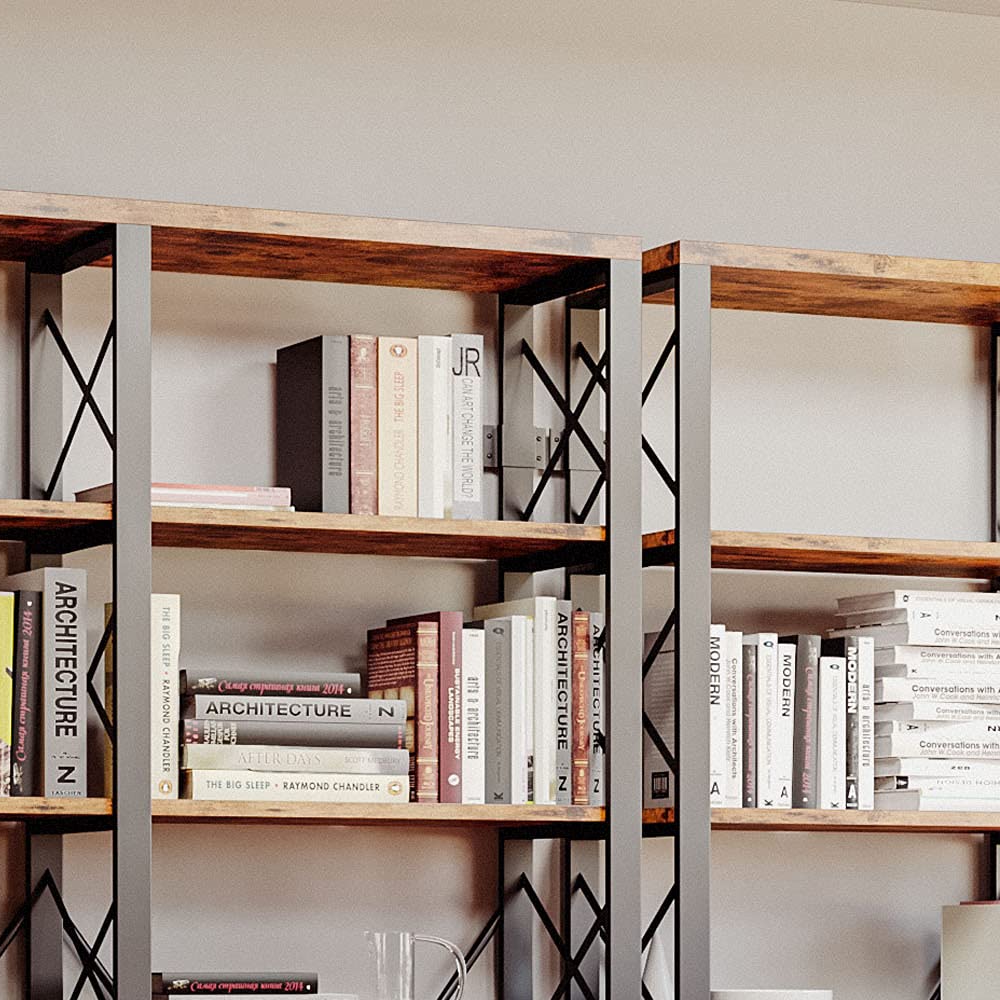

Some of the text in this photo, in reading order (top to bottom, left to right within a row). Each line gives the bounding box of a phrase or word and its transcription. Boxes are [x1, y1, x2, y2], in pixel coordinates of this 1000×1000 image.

[452, 347, 480, 376] JR
[462, 378, 473, 394] CAN
[329, 387, 343, 404] arts
[394, 372, 404, 422] THE BIG SLEEP
[462, 396, 473, 412] ART
[462, 413, 473, 446] CHANGE
[329, 420, 344, 476] architecture
[462, 448, 473, 463] THE
[162, 607, 170, 622] THE
[162, 625, 170, 640] BIG
[935, 628, 989, 637] Conversations
[55, 582, 77, 737] ARCHITECTURE
[162, 643, 170, 667] SLEEP
[710, 637, 720, 705] MODERN
[218, 681, 344, 695] Самая страшная книга 2014
[558, 613, 568, 750] ARCHITECTURE
[782, 655, 791, 716] MODERN
[848, 647, 856, 713] MODERN
[206, 702, 351, 717] ARCHITECTURE
[378, 707, 394, 717] N
[238, 752, 321, 764] AFTER DAYS
[57, 766, 76, 783] N
[206, 780, 380, 791] THE BIG SLEEP RAYMOND CHANDLER
[558, 777, 567, 791] N
[711, 782, 720, 795] A
[781, 786, 788, 798] A
[190, 981, 217, 992] Самая
[219, 983, 258, 993] страшная
[285, 982, 303, 991] 2014
